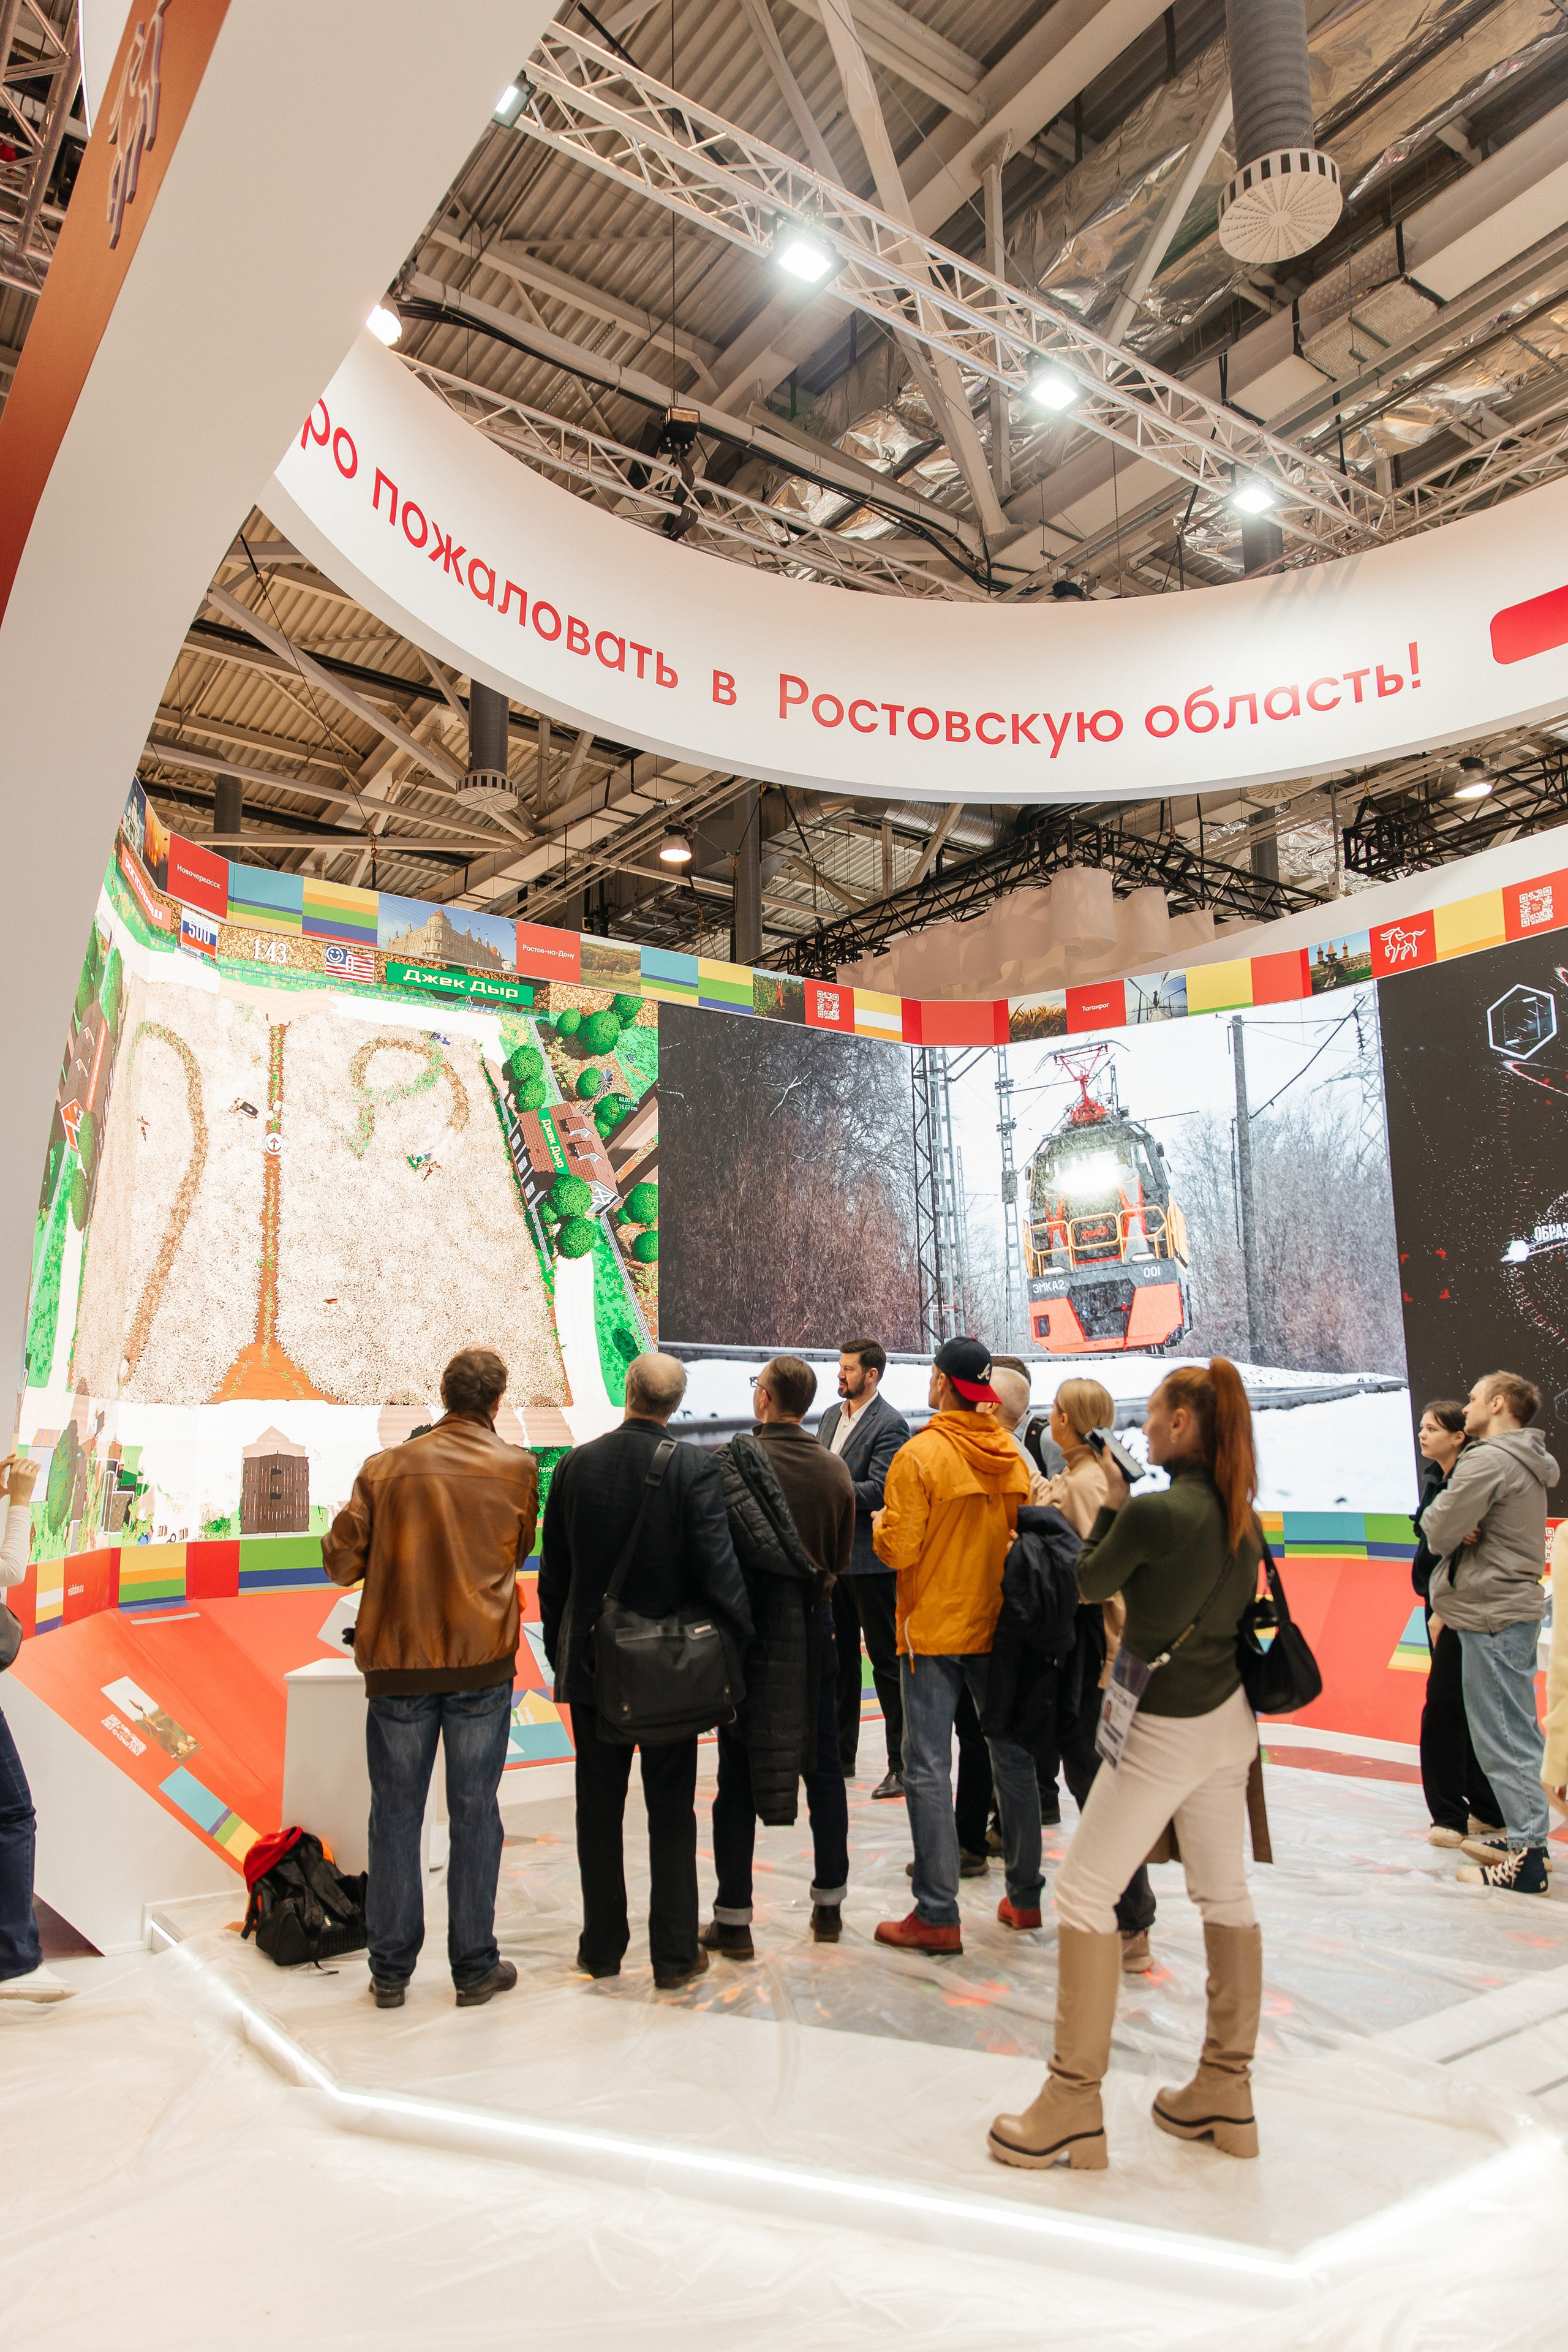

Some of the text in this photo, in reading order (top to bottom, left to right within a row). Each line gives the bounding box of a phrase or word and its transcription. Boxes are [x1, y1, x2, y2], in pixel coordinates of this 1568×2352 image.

[372, 468, 678, 688] пожаловать
[713, 670, 736, 705] в
[780, 674, 1123, 758] Ростовскую
[1145, 641, 1421, 737] область!
[176, 864, 221, 889] Новочеркасск
[188, 918, 210, 945] 500
[254, 938, 287, 964] 1:43
[522, 944, 575, 960] Ростов-на-Дону
[402, 969, 519, 999] Джек Дыр
[1082, 1003, 1110, 1012] Таганрог
[541, 1118, 565, 1169] Джек Дыр
